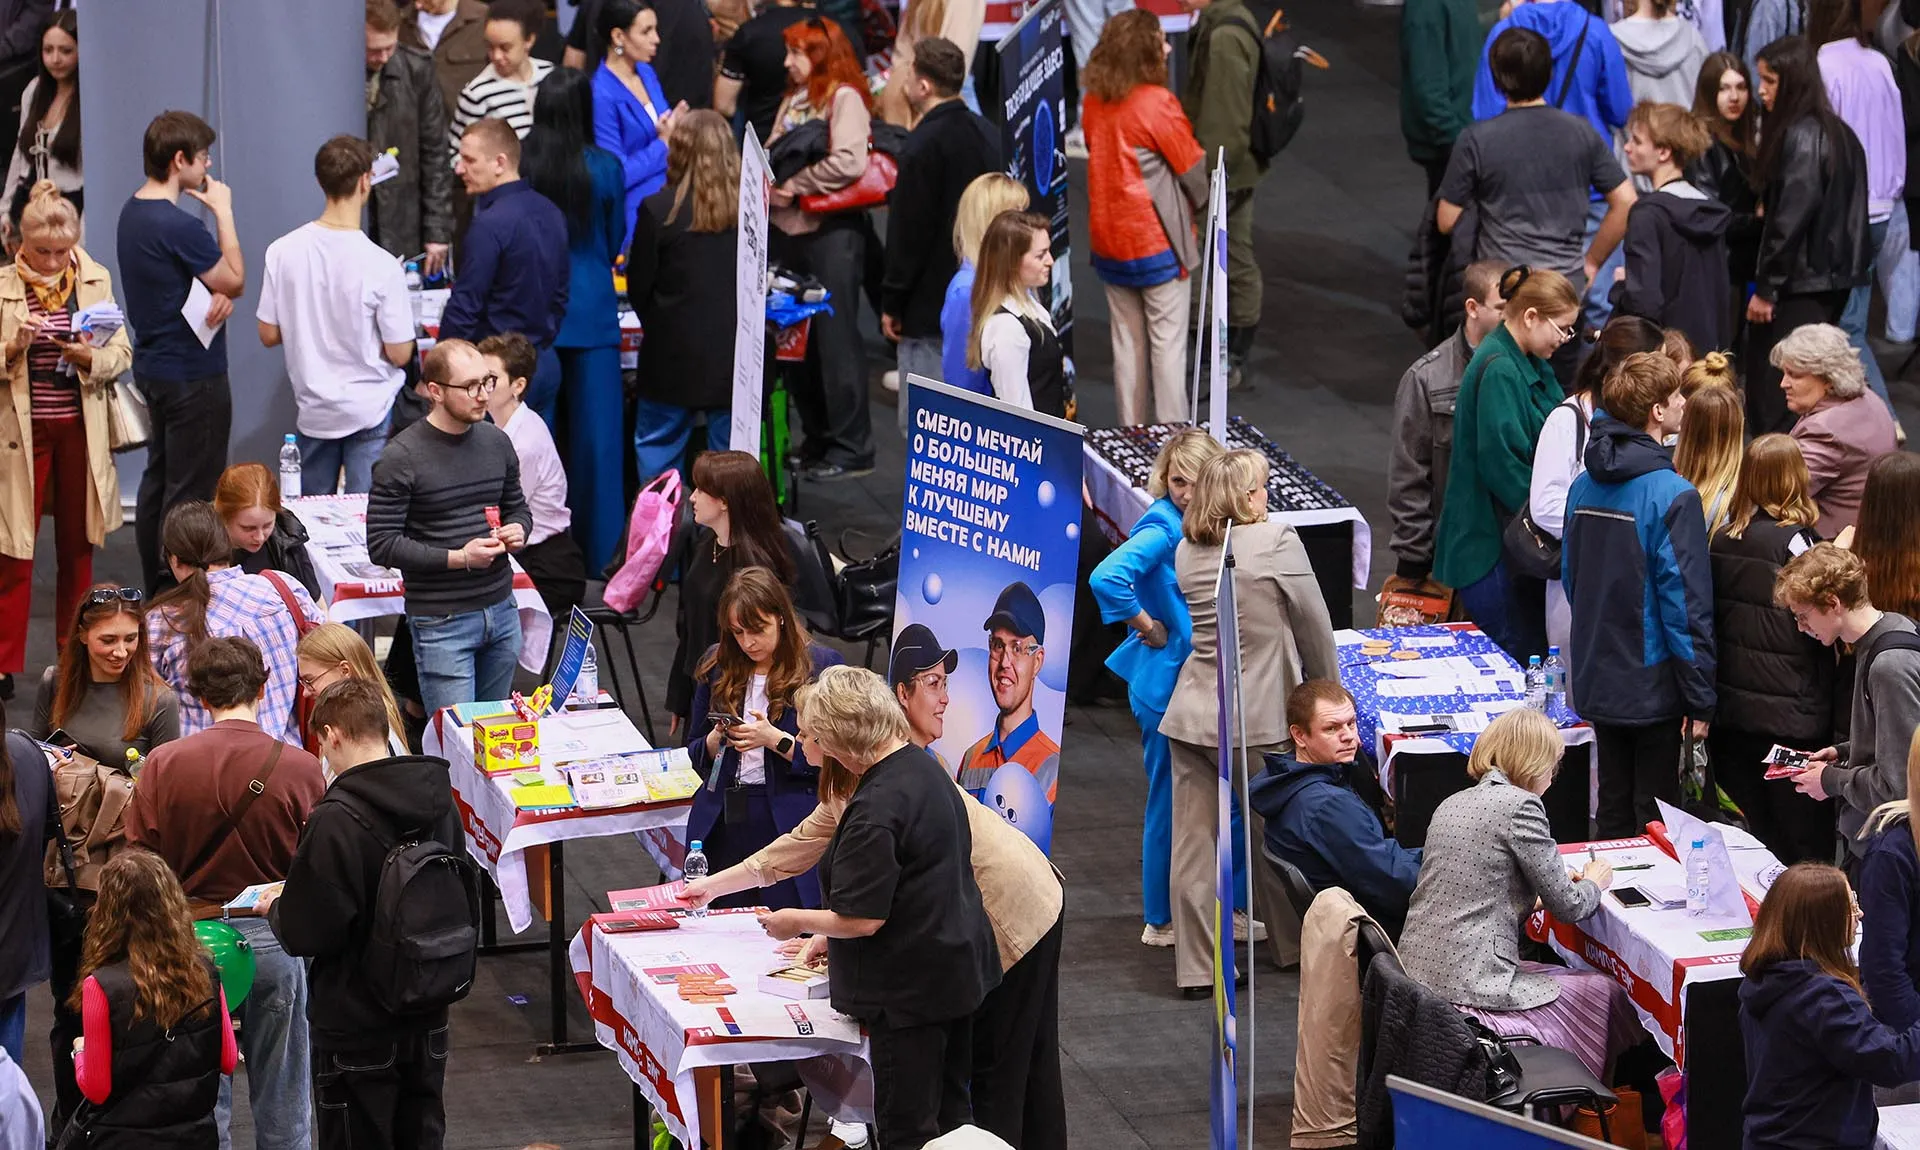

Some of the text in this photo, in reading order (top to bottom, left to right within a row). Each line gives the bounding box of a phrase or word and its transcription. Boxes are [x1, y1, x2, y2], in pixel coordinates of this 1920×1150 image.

[913, 436, 1020, 488] О БОЛЬШЕМ,
[916, 407, 1043, 465] СМЕЛО МЕЧТАЙ
[910, 459, 1008, 506] МЕНЯЯ МИР
[907, 485, 1010, 533] К ЛУЧШЕМУ
[905, 509, 1042, 571] ВМЕСТЕ С НАМИ!
